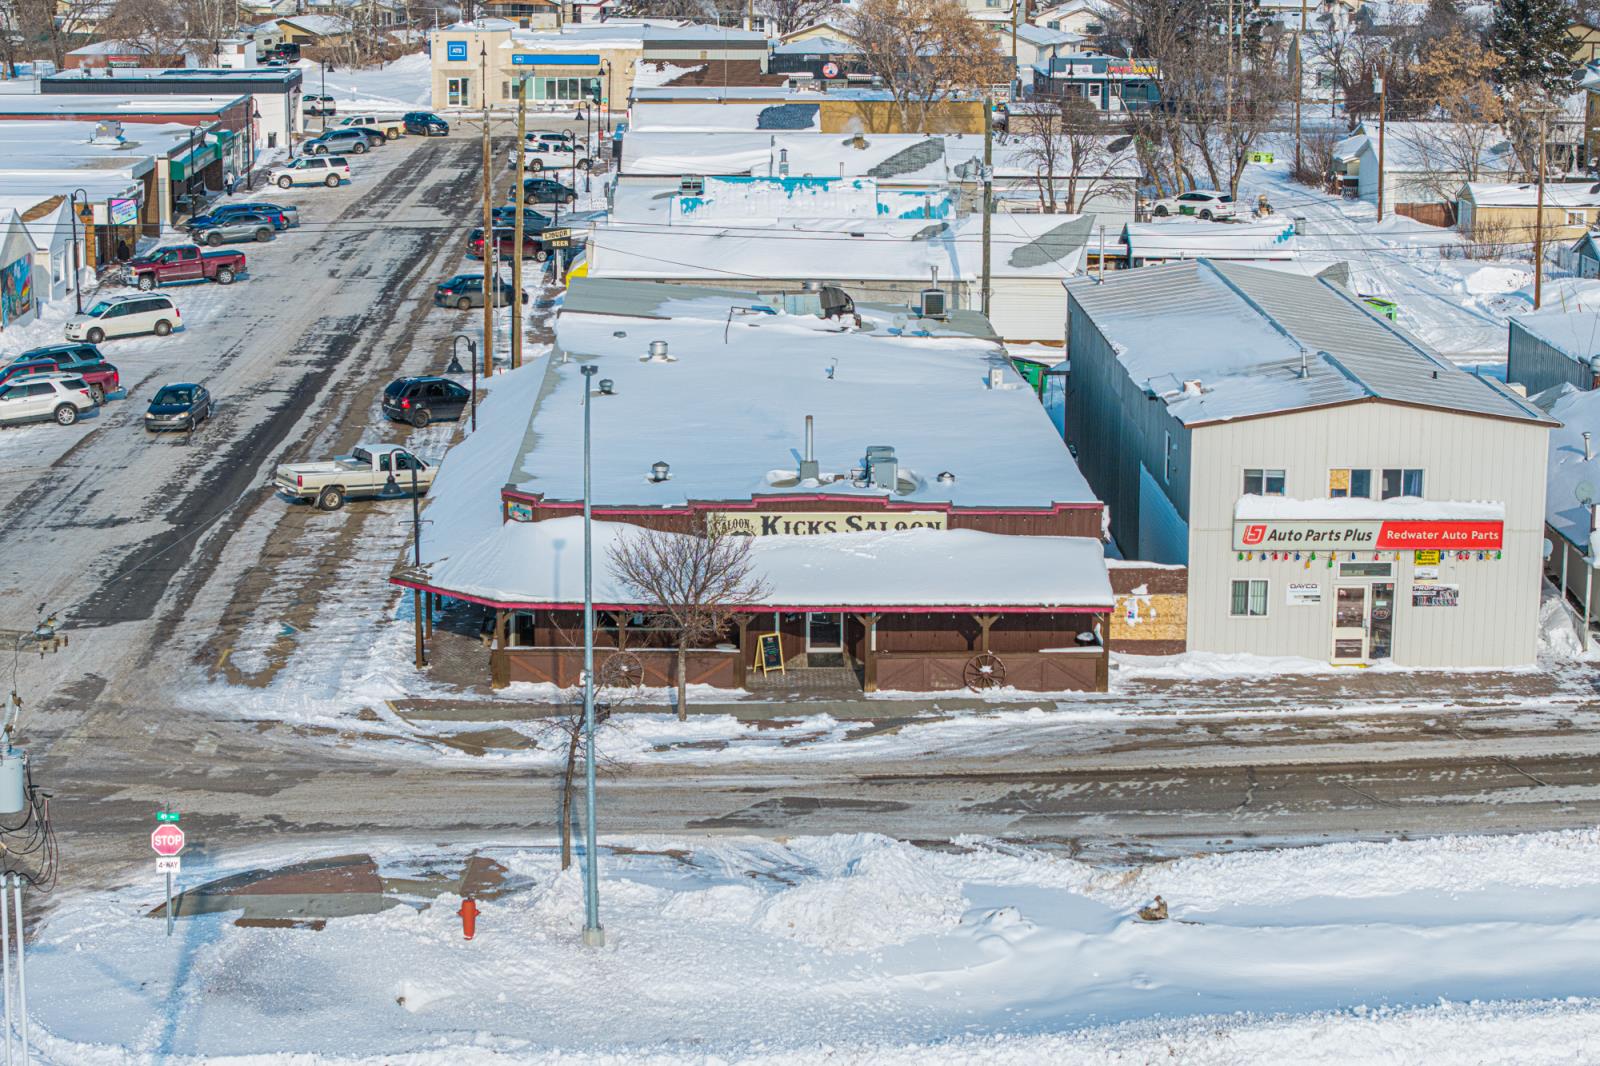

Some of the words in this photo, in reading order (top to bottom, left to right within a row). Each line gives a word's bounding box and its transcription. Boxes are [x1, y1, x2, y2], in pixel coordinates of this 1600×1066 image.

[1267, 529, 1302, 541] Auto
[1305, 529, 1341, 541] Parts
[1344, 528, 1373, 541] Plus
[1387, 530, 1439, 540] Redwater
[1441, 530, 1468, 540] Auto
[1471, 530, 1499, 540] Parts
[155, 835, 182, 845] STOP
